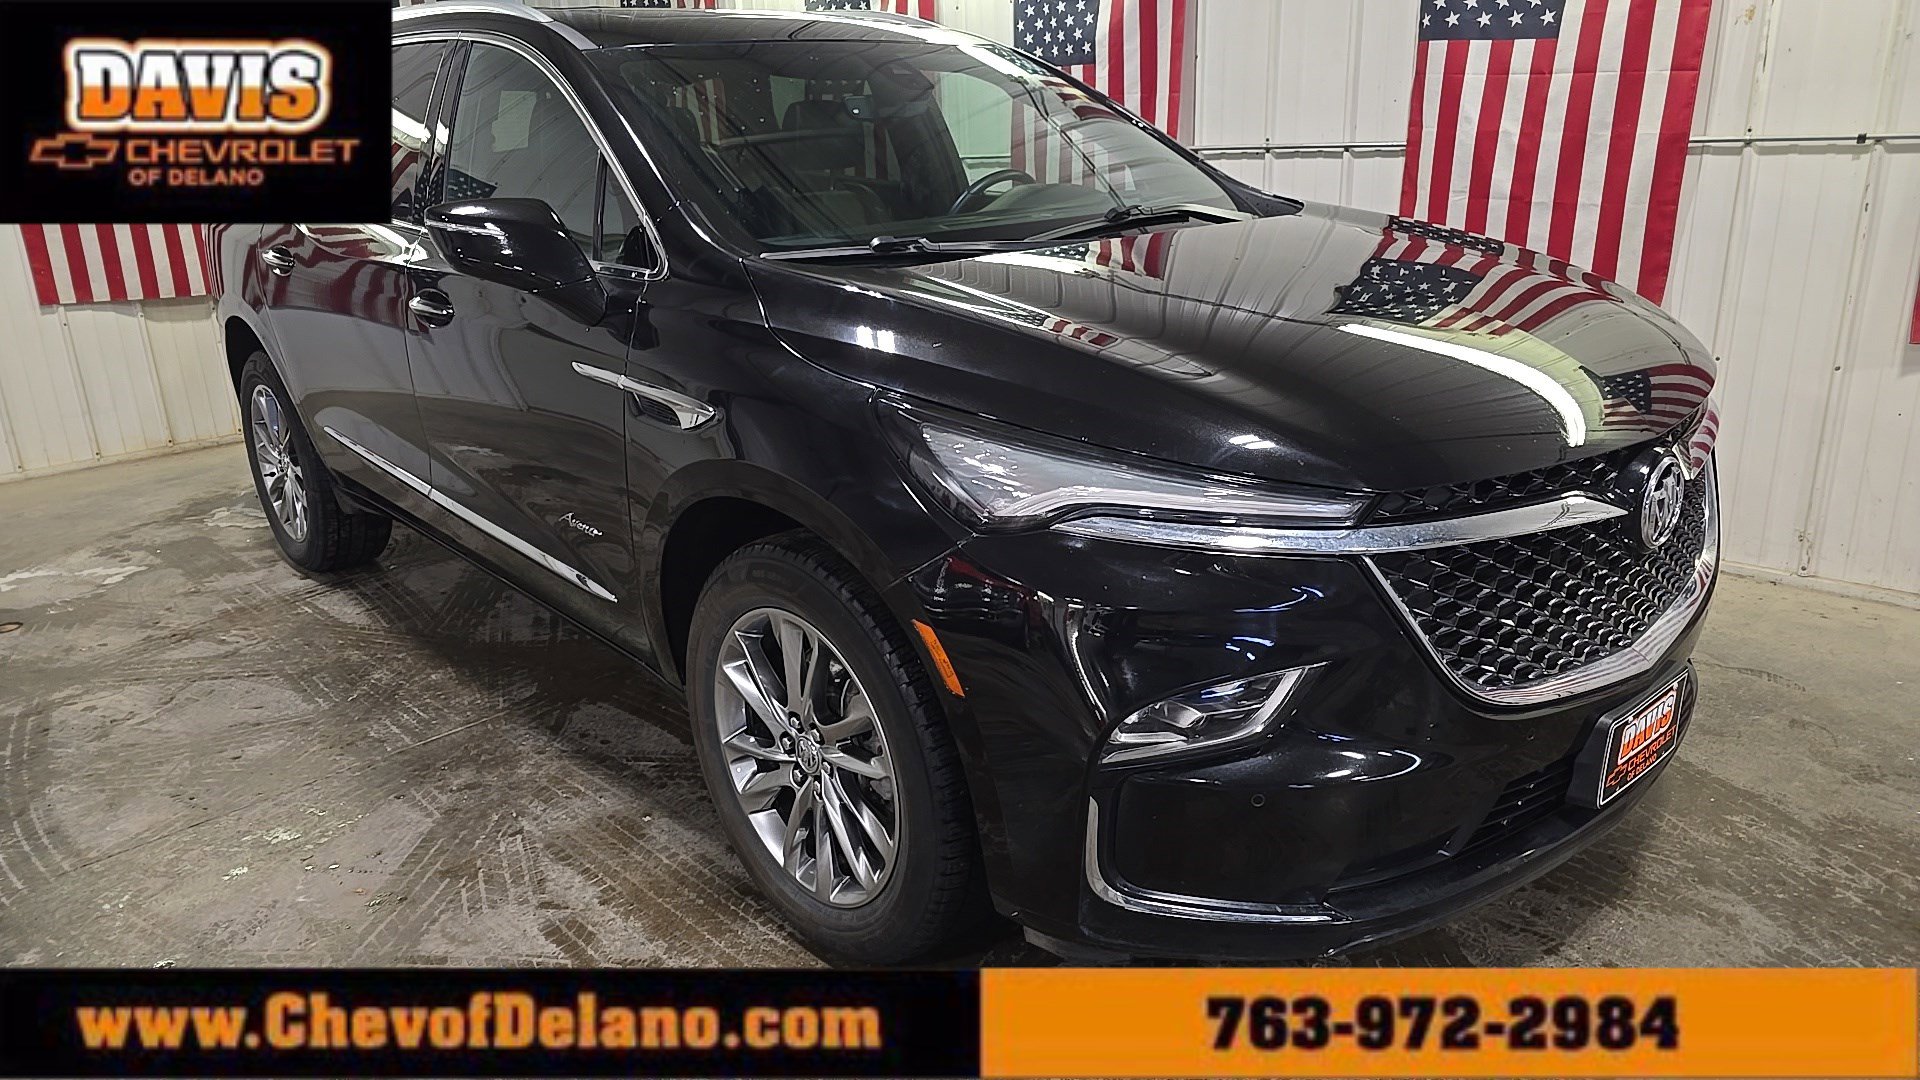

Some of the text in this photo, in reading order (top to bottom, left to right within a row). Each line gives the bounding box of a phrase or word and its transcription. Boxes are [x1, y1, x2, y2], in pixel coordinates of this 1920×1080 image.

[1619, 692, 1676, 763] DAVIS
[1627, 724, 1676, 771] CHEVROLET
[1626, 753, 1658, 781] OF DELANO
